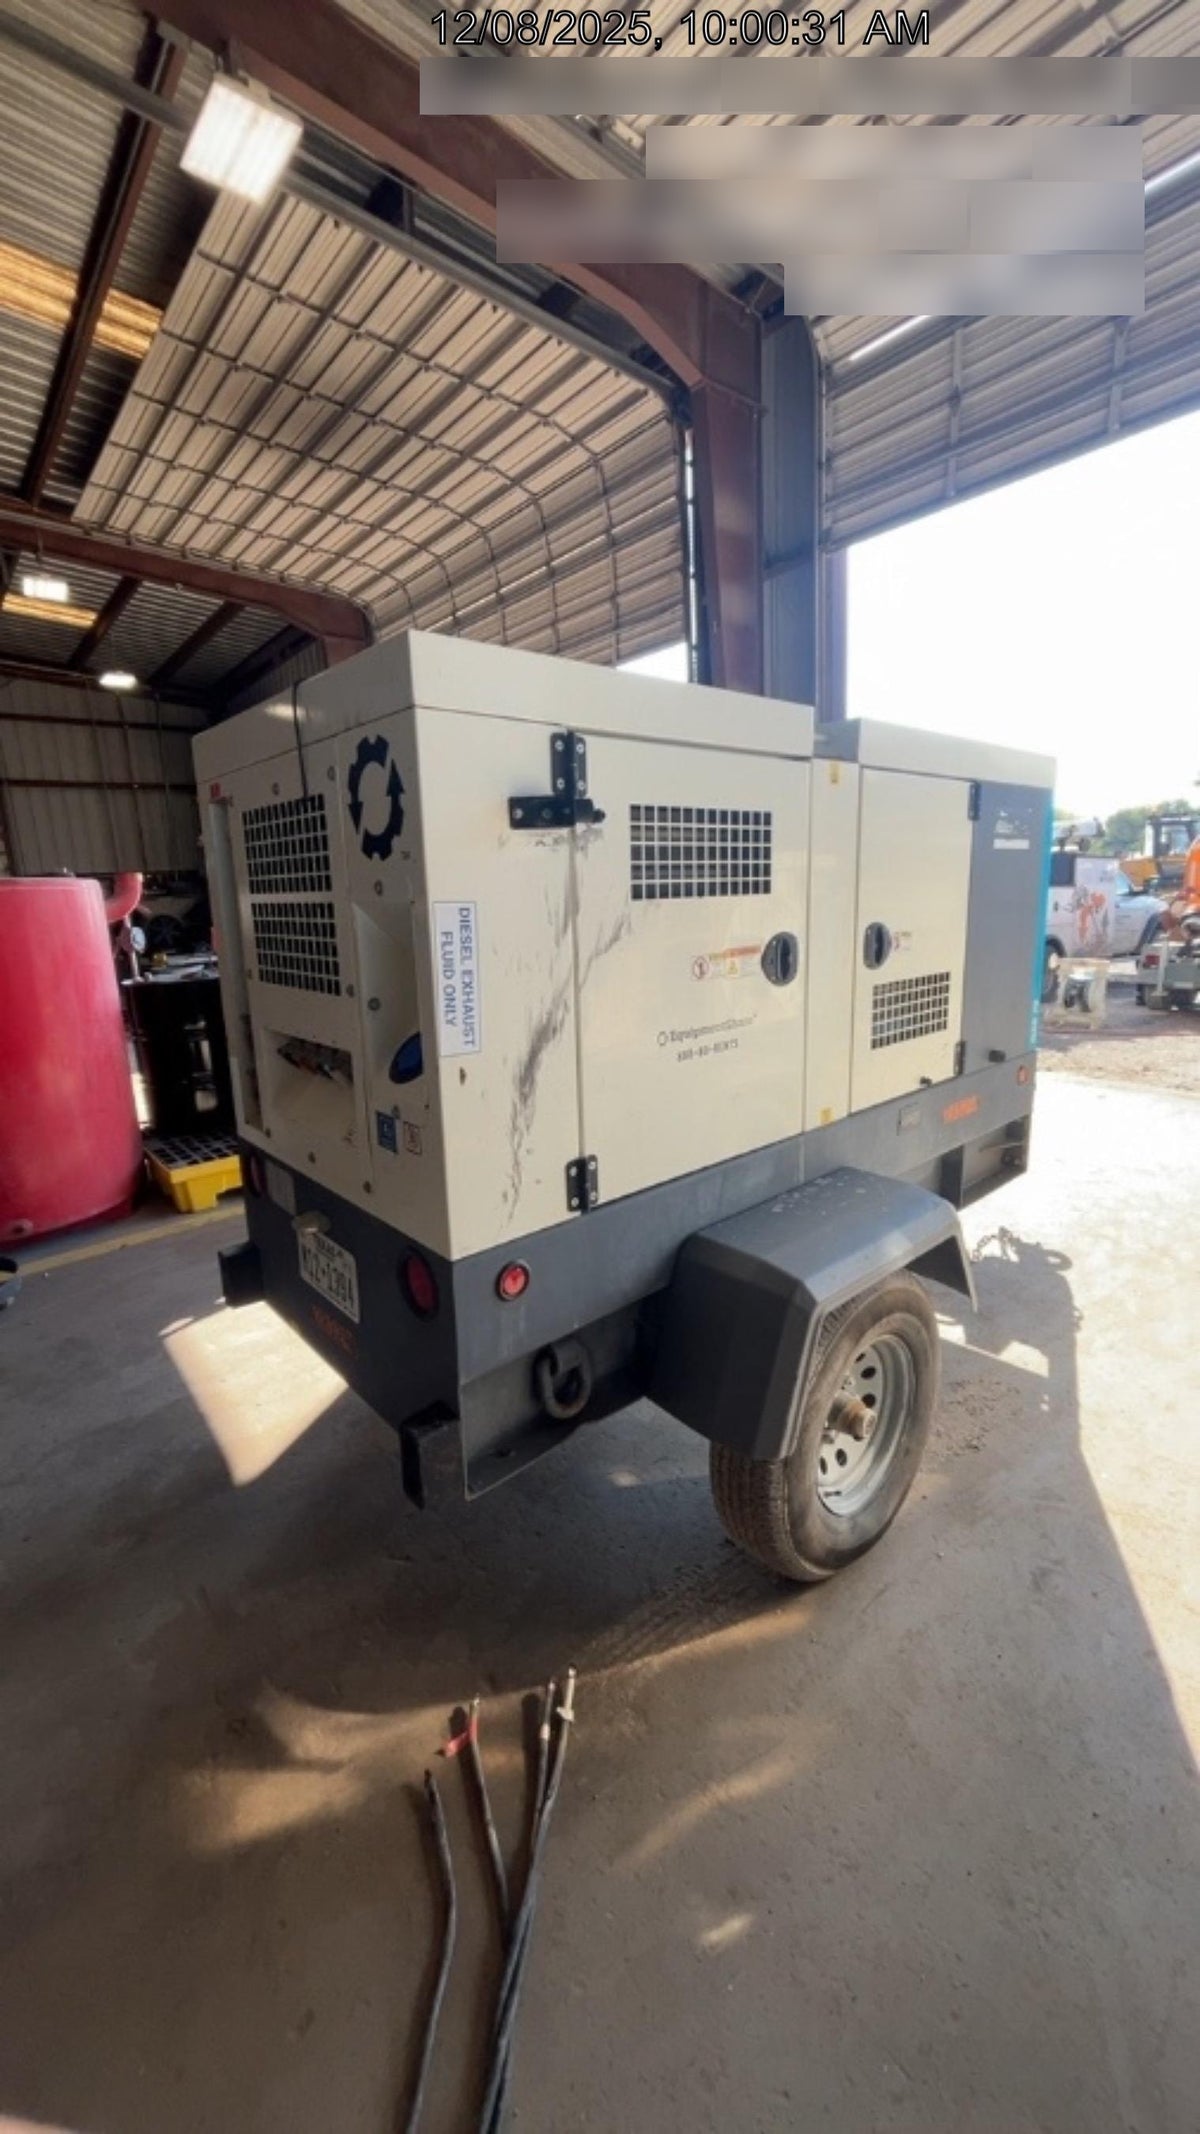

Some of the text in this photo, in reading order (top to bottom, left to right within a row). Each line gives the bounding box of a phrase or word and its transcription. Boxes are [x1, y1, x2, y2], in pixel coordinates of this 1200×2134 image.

[440, 931, 458, 1027] FLUID ONLY
[458, 907, 476, 1047] DIESEL EXHAUST
